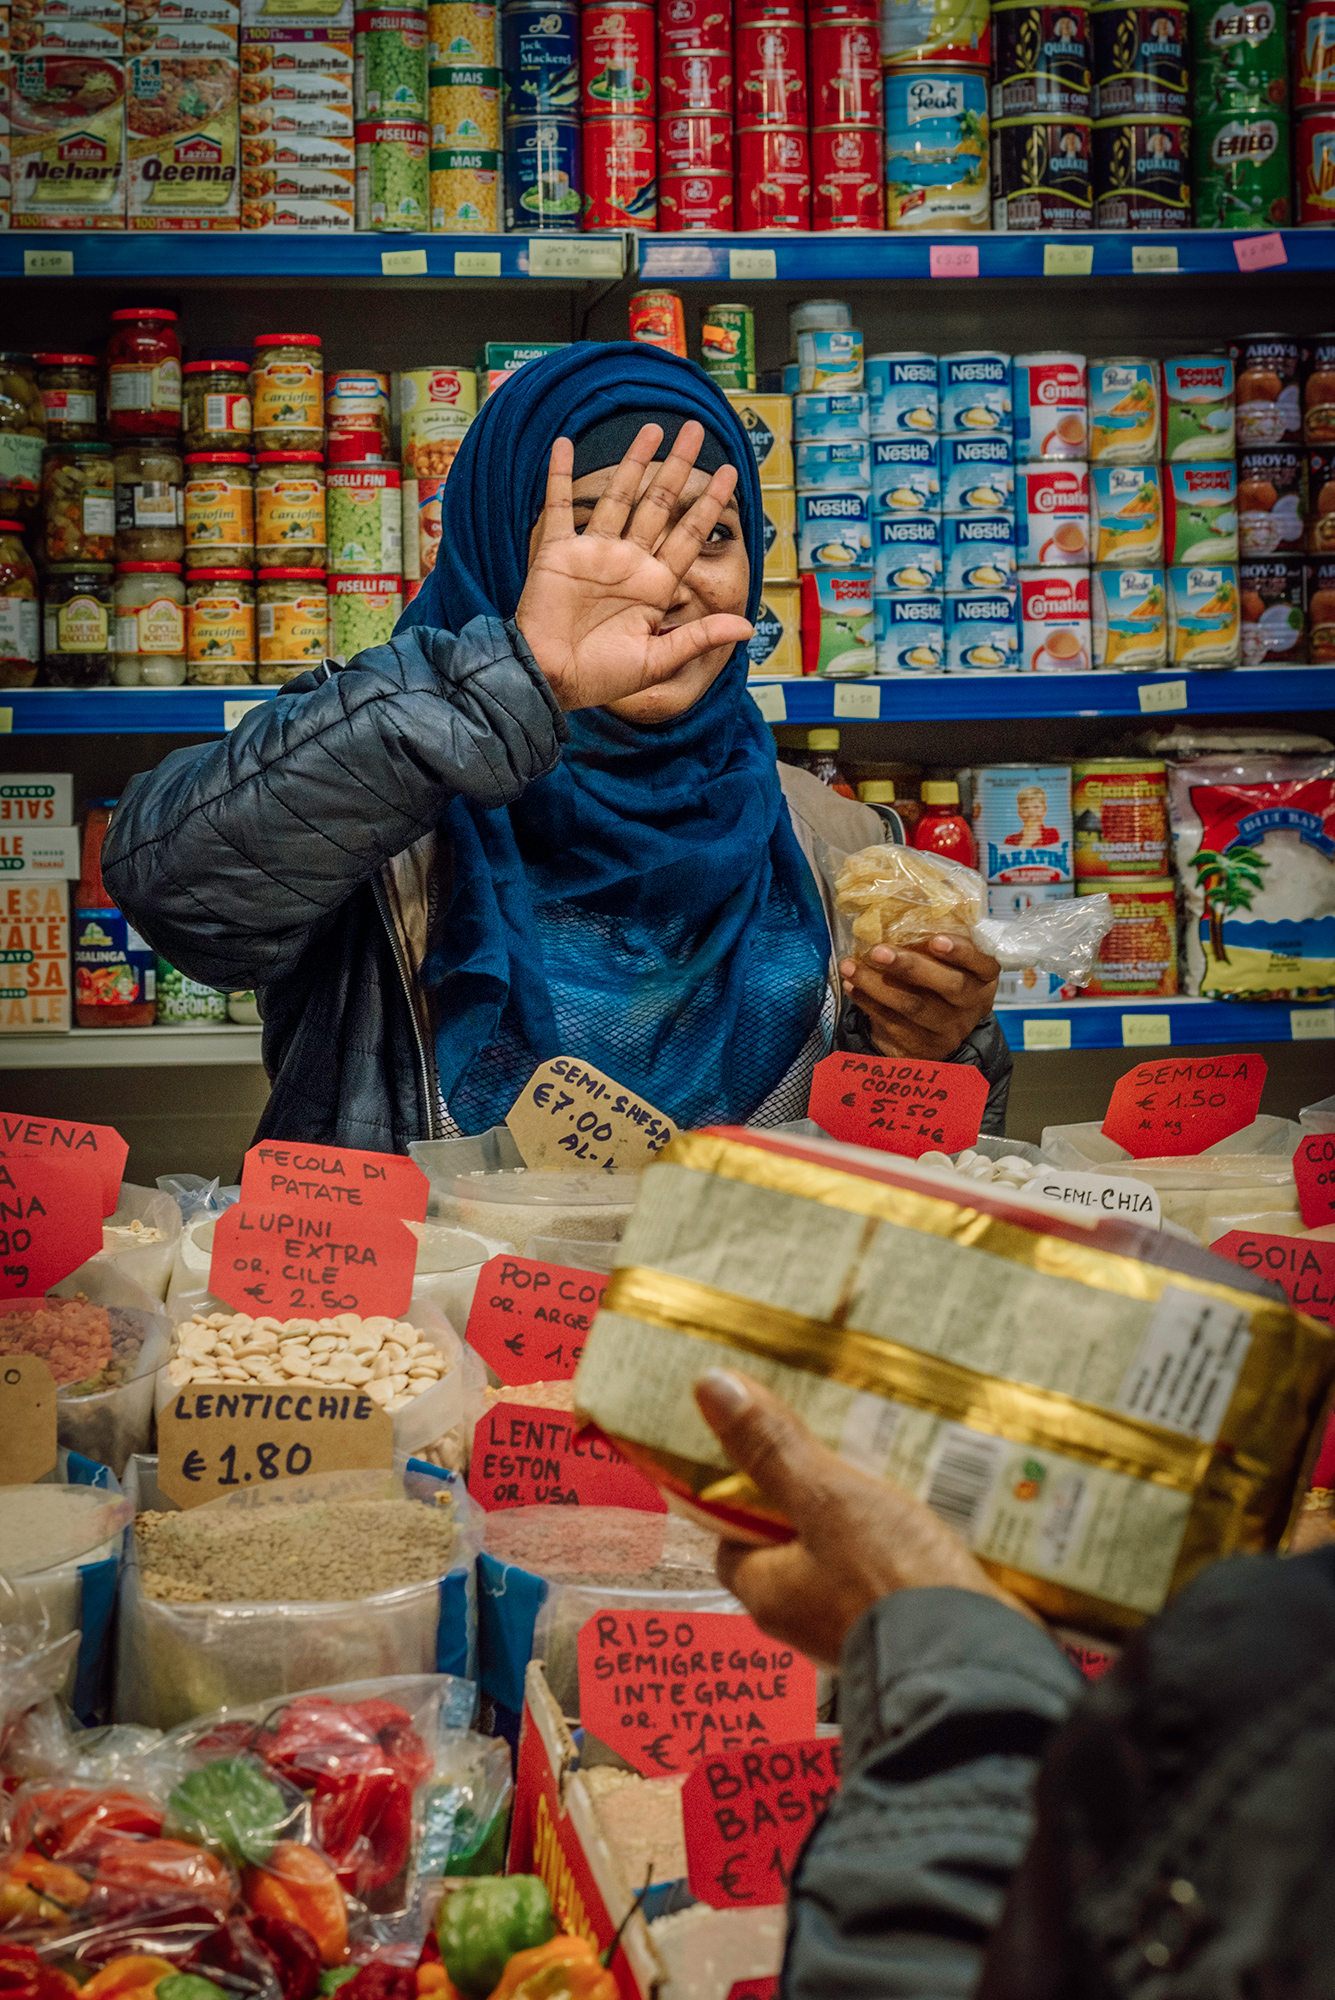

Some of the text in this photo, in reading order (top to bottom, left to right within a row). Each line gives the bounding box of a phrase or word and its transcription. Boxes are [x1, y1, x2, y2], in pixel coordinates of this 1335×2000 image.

[1213, 14, 1271, 39] MILO
[1043, 42, 1085, 58] QUAKER
[451, 72, 483, 84] MAIS
[909, 81, 958, 112] Peak
[376, 128, 416, 141] PISELLI
[63, 144, 103, 157] Laziza
[179, 148, 218, 160] Laziza
[1217, 133, 1274, 158] MILO
[25, 161, 123, 180] Nehari
[142, 158, 237, 182] Qeema
[450, 156, 482, 168] MAIS
[1050, 157, 1089, 173] QUAKER
[1136, 157, 1181, 173] QUAKER
[952, 364, 1003, 381] Nestlé
[877, 444, 929, 461] Nestlé
[957, 443, 1008, 461] Nestlé
[1241, 454, 1297, 468] AROY-D
[327, 474, 386, 487] PISELLI FINI
[808, 499, 861, 517] Nestlé
[884, 523, 935, 541] Nestlé
[959, 522, 1010, 539] Nestlé
[337, 580, 377, 593] PISELLI
[957, 600, 1010, 619] Nestlé
[2, 786, 51, 796] IODATO
[1, 800, 54, 819] SALE
[1288, 812, 1318, 831] BAY
[841, 1059, 940, 1084] FAGIOLI
[1135, 1063, 1249, 1087] SEMOLA
[862, 1078, 948, 1101] CORONA
[841, 1093, 857, 1108] €
[1135, 1090, 1227, 1111] € 1.50
[258, 1149, 387, 1181] FECOLA DI
[271, 1175, 363, 1206] PATATE
[1043, 1185, 1154, 1212] SEMI-CHIA
[239, 1212, 331, 1238] LUPINI
[285, 1239, 378, 1267] EXTRA
[1238, 1241, 1323, 1277] SOIA
[282, 1264, 340, 1285] CILE
[500, 1262, 551, 1291] POP
[243, 1283, 359, 1310] € 2.50
[504, 1333, 526, 1356] €
[174, 1393, 373, 1422] LENTICCHIE
[483, 1453, 561, 1482] ESTON
[535, 1485, 580, 1507] USA
[597, 1615, 695, 1648] RISO
[594, 1650, 794, 1680] SEMIGREGGIO
[672, 1711, 766, 1733] ITALIA
[641, 1733, 679, 1770] €
[715, 1852, 754, 1900] €
